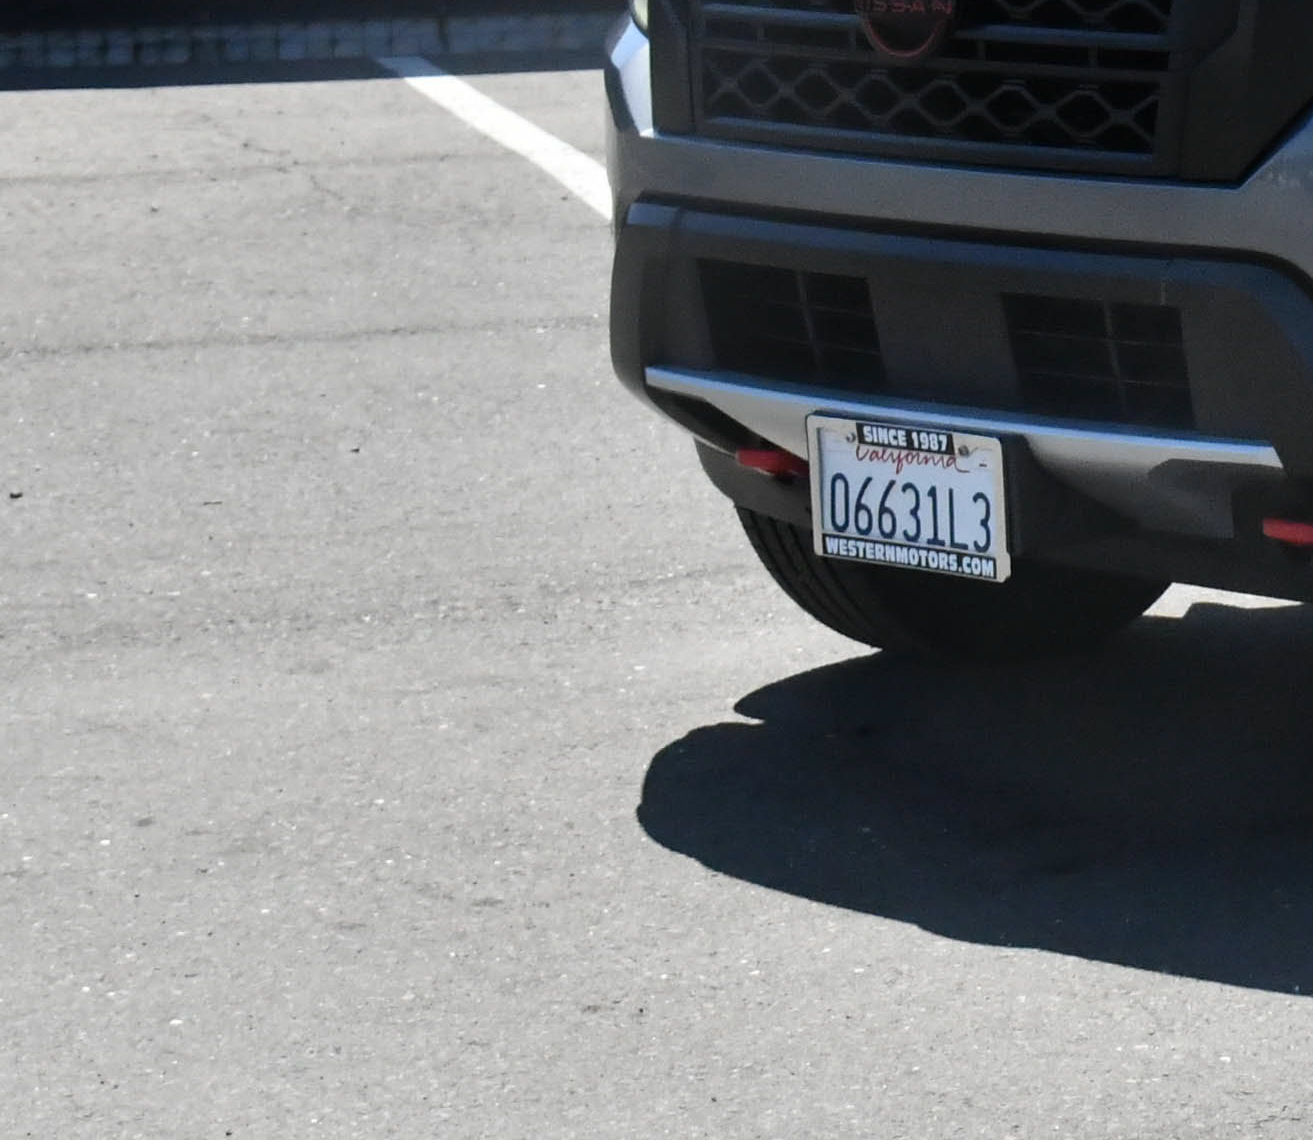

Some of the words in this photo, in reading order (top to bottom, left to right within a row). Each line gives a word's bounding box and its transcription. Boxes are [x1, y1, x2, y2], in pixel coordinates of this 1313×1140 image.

[863, 425, 907, 442] SINCE
[911, 431, 948, 452] 1987
[830, 472, 991, 553] 06631L3
[825, 536, 994, 578] WESTERNMOTORS.COM
